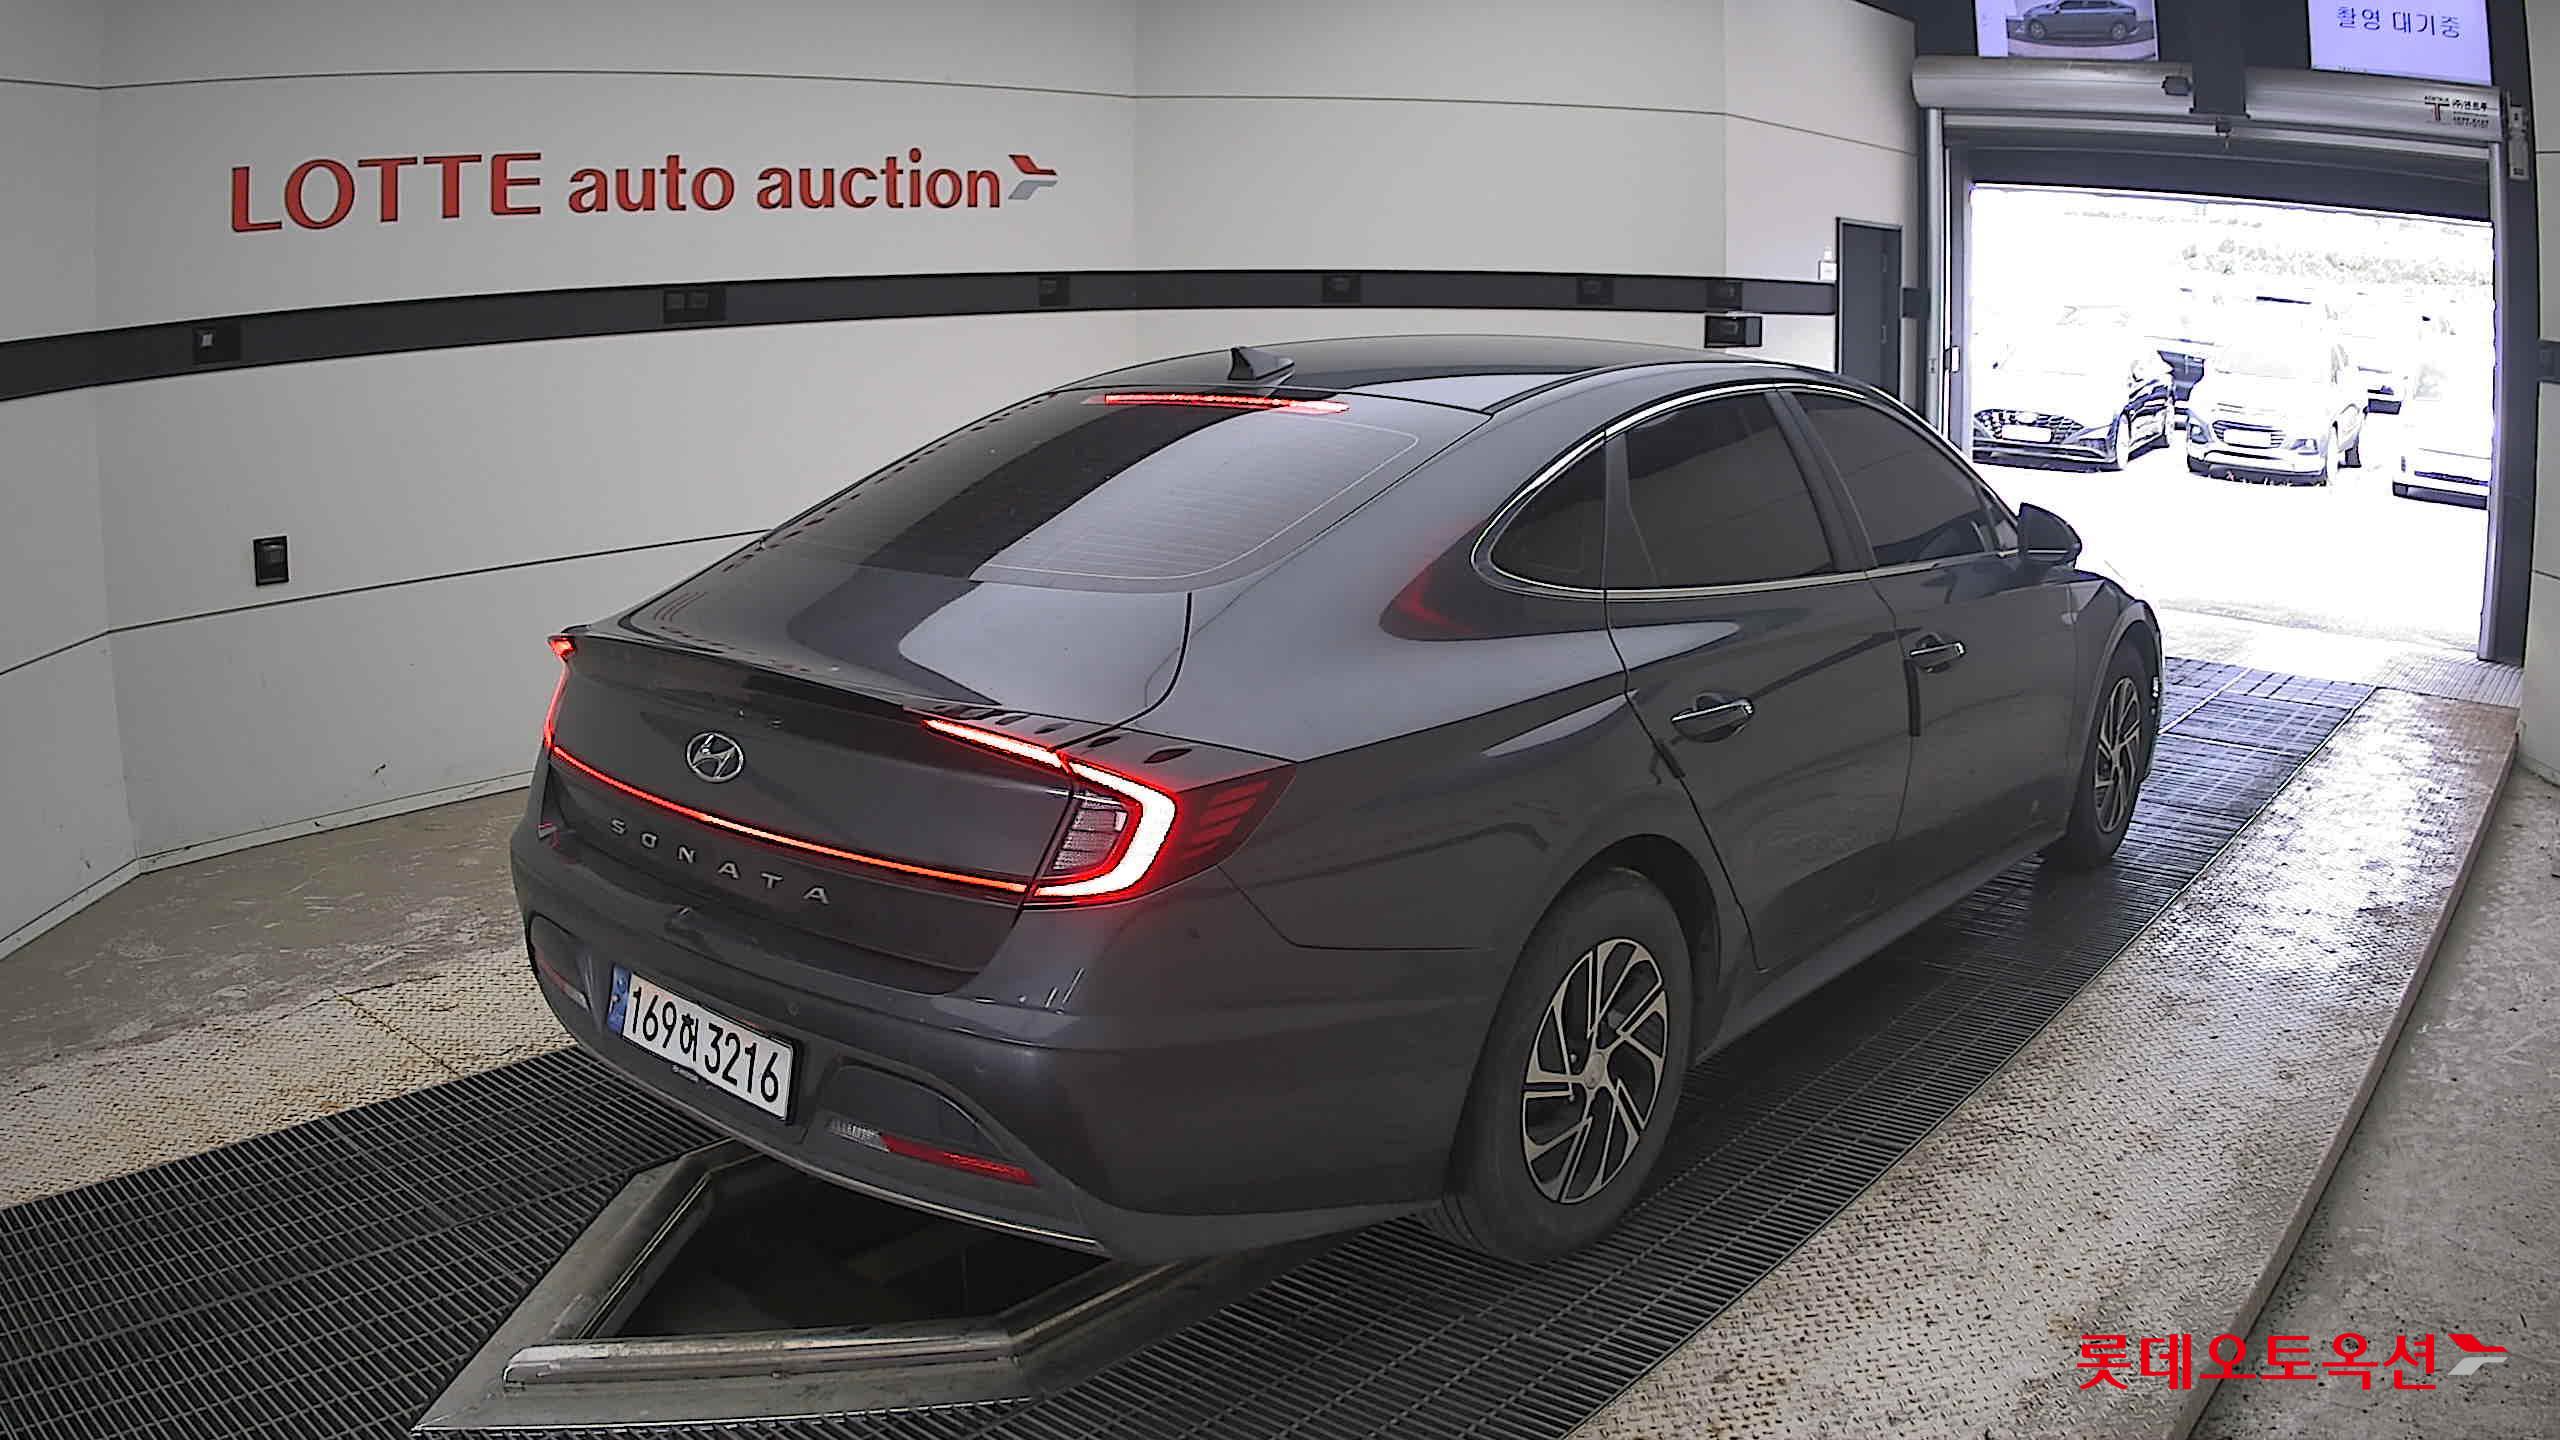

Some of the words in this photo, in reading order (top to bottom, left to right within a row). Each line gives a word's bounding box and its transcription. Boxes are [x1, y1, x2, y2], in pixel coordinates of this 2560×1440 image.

[2337, 6, 2381, 31] 촬영
[2392, 11, 2460, 39] 대기중
[230, 151, 543, 232] LOTTE
[568, 154, 735, 214] auto
[756, 147, 1002, 210] auction
[611, 817, 830, 905] SONATA
[632, 986, 779, 1103] 169허3216
